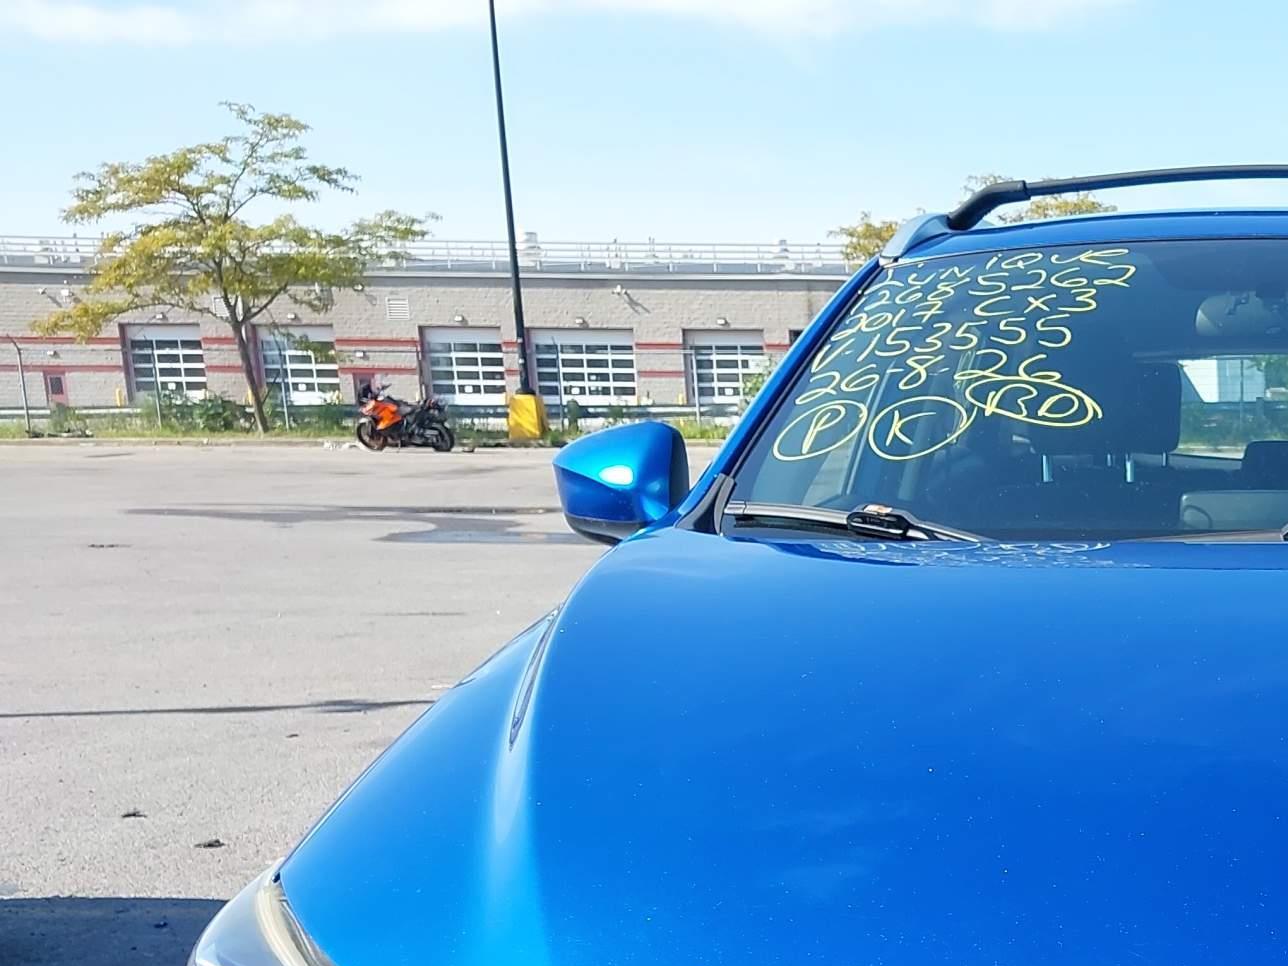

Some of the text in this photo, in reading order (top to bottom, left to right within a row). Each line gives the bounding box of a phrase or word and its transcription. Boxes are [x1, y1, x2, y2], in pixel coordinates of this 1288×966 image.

[850, 265, 1136, 317] 12685262
[831, 299, 944, 341] 2017
[802, 404, 846, 454] P
[886, 410, 937, 446] K
